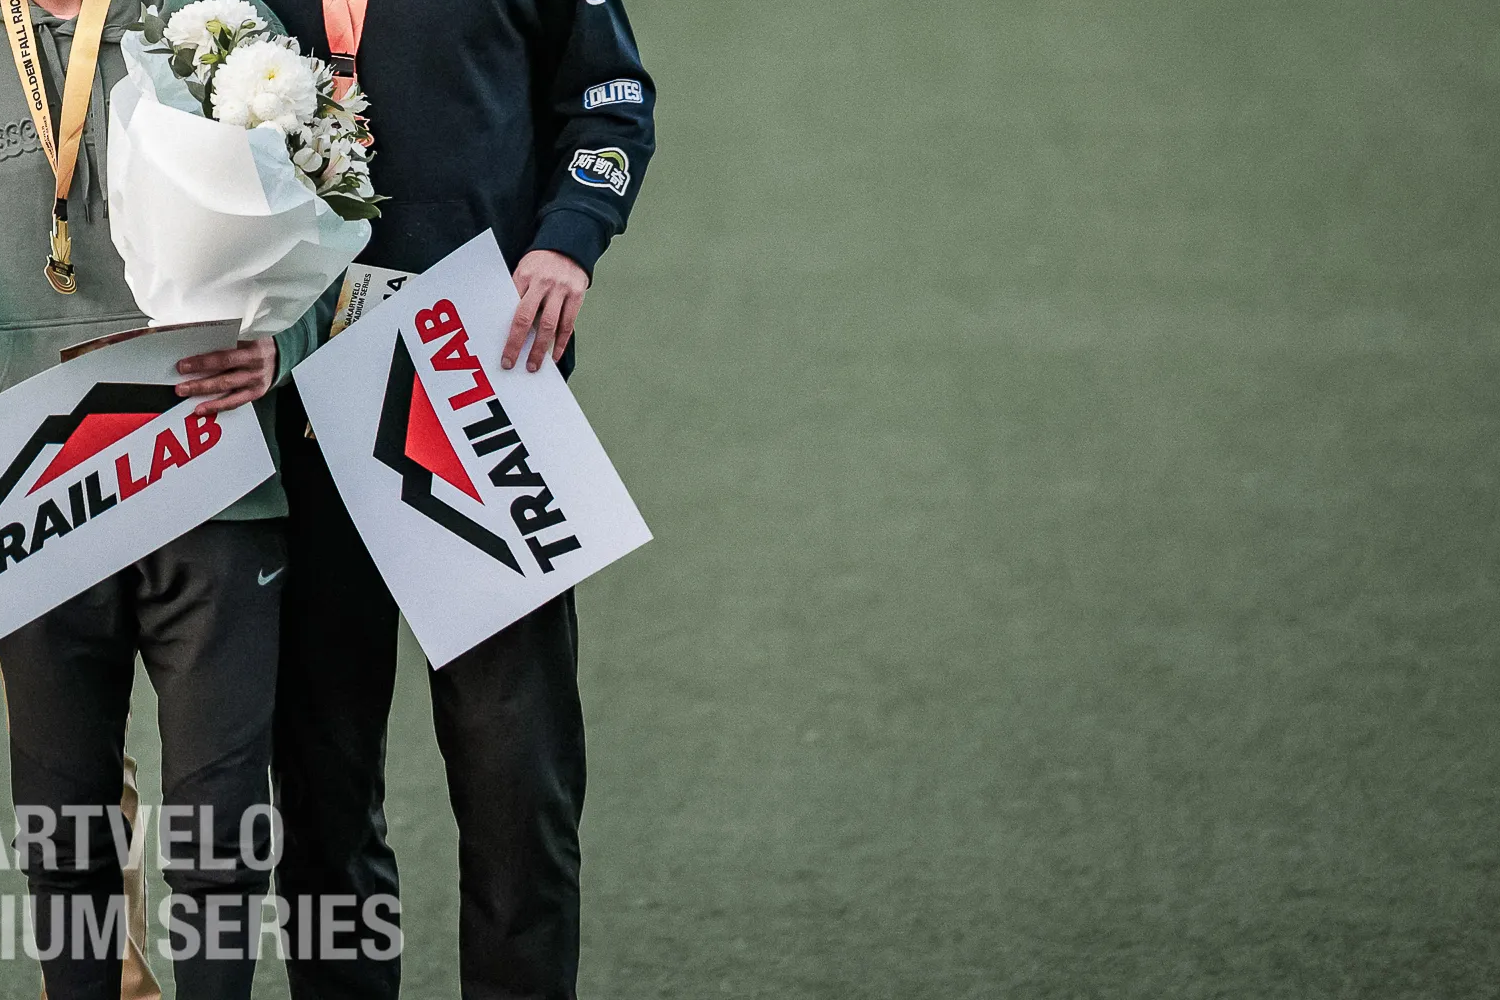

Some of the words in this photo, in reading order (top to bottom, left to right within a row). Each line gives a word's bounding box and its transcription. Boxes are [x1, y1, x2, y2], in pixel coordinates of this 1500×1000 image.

[16, 24, 31, 57] FALL
[23, 59, 43, 111] GOLDEN
[573, 154, 626, 190] 斯凯奇
[345, 282, 361, 327] SAKARTVELO
[360, 273, 372, 297] SERIES
[414, 298, 583, 575] TRAILLAB
